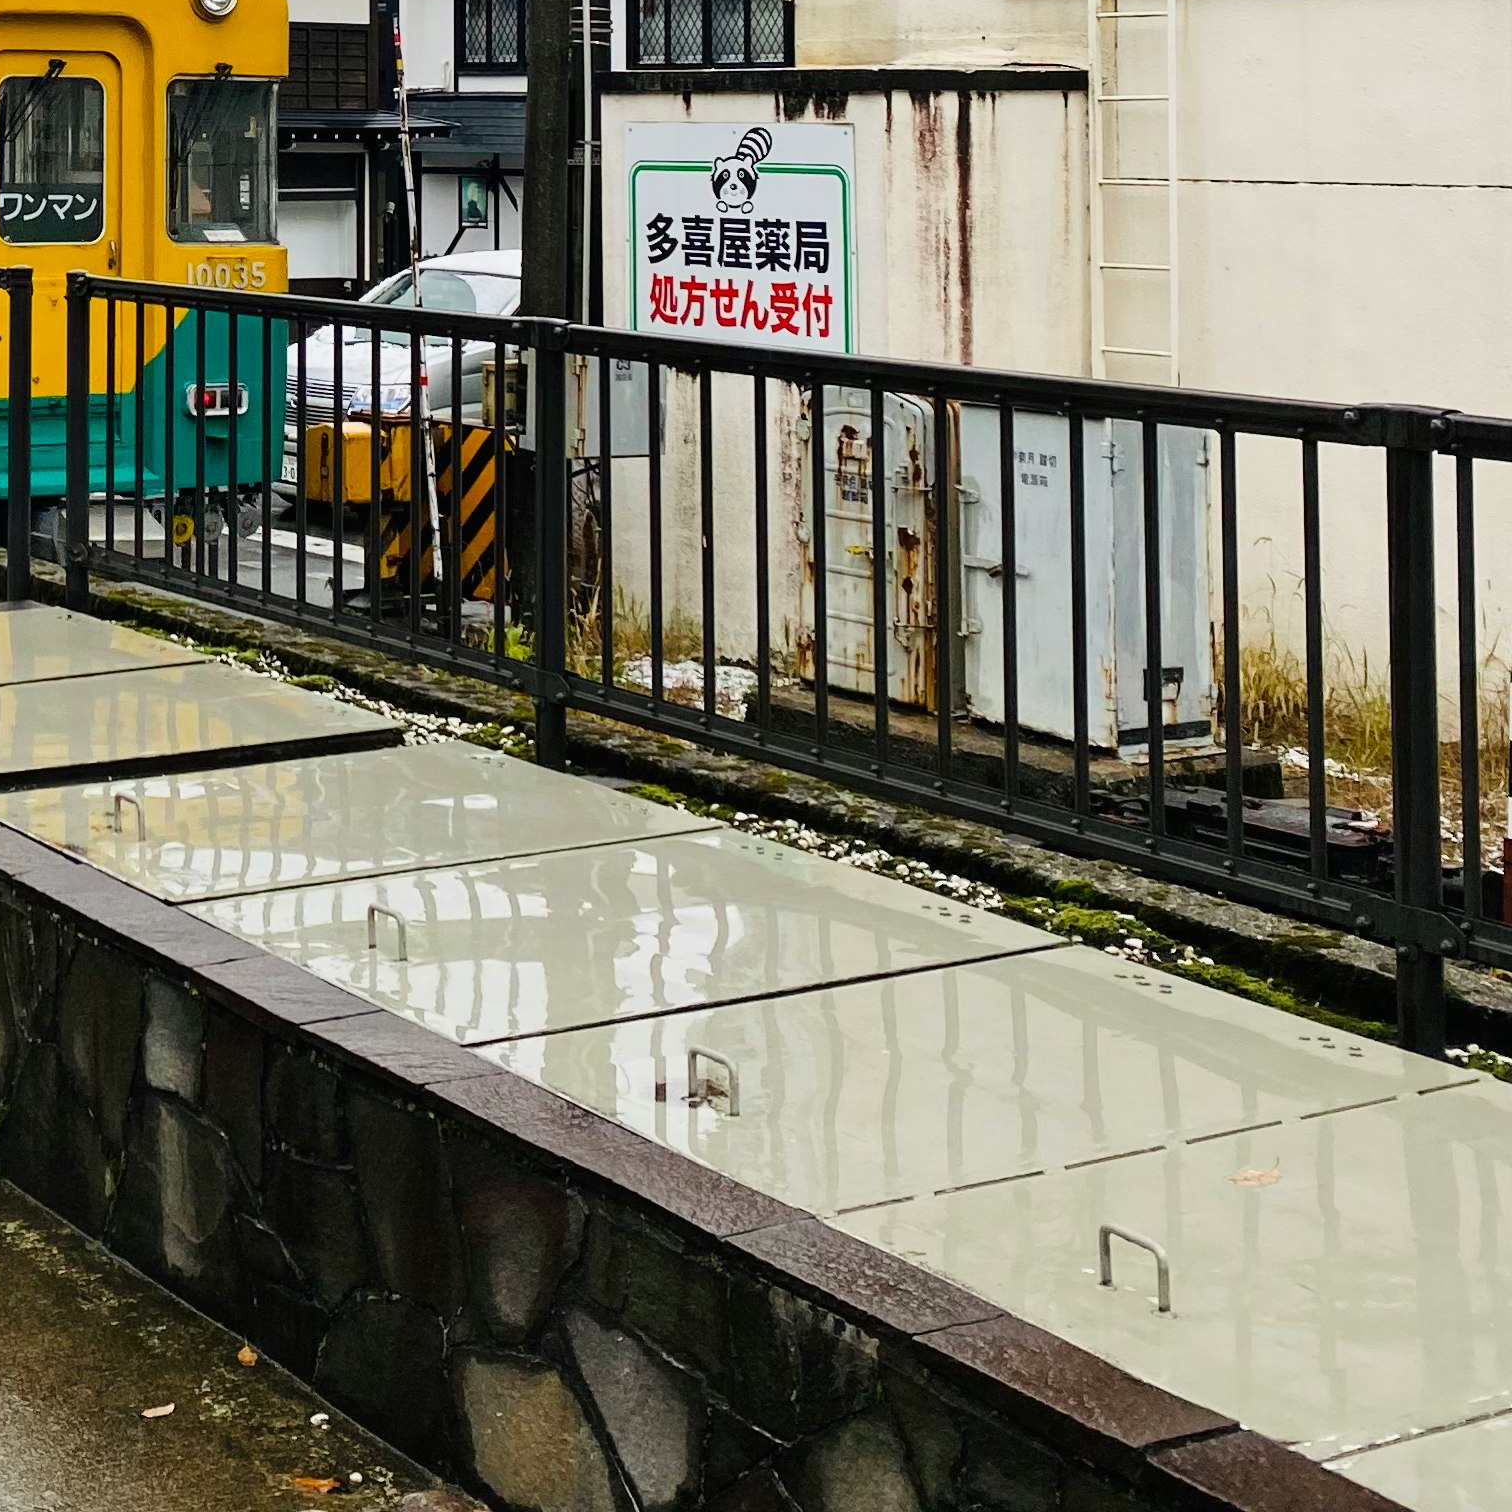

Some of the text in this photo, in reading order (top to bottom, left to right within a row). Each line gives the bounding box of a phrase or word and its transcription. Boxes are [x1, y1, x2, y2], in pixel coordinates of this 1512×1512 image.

[646, 212, 830, 274] 多喜屋薬局
[187, 261, 267, 289] 10035
[649, 273, 833, 337] 処方せん受付
